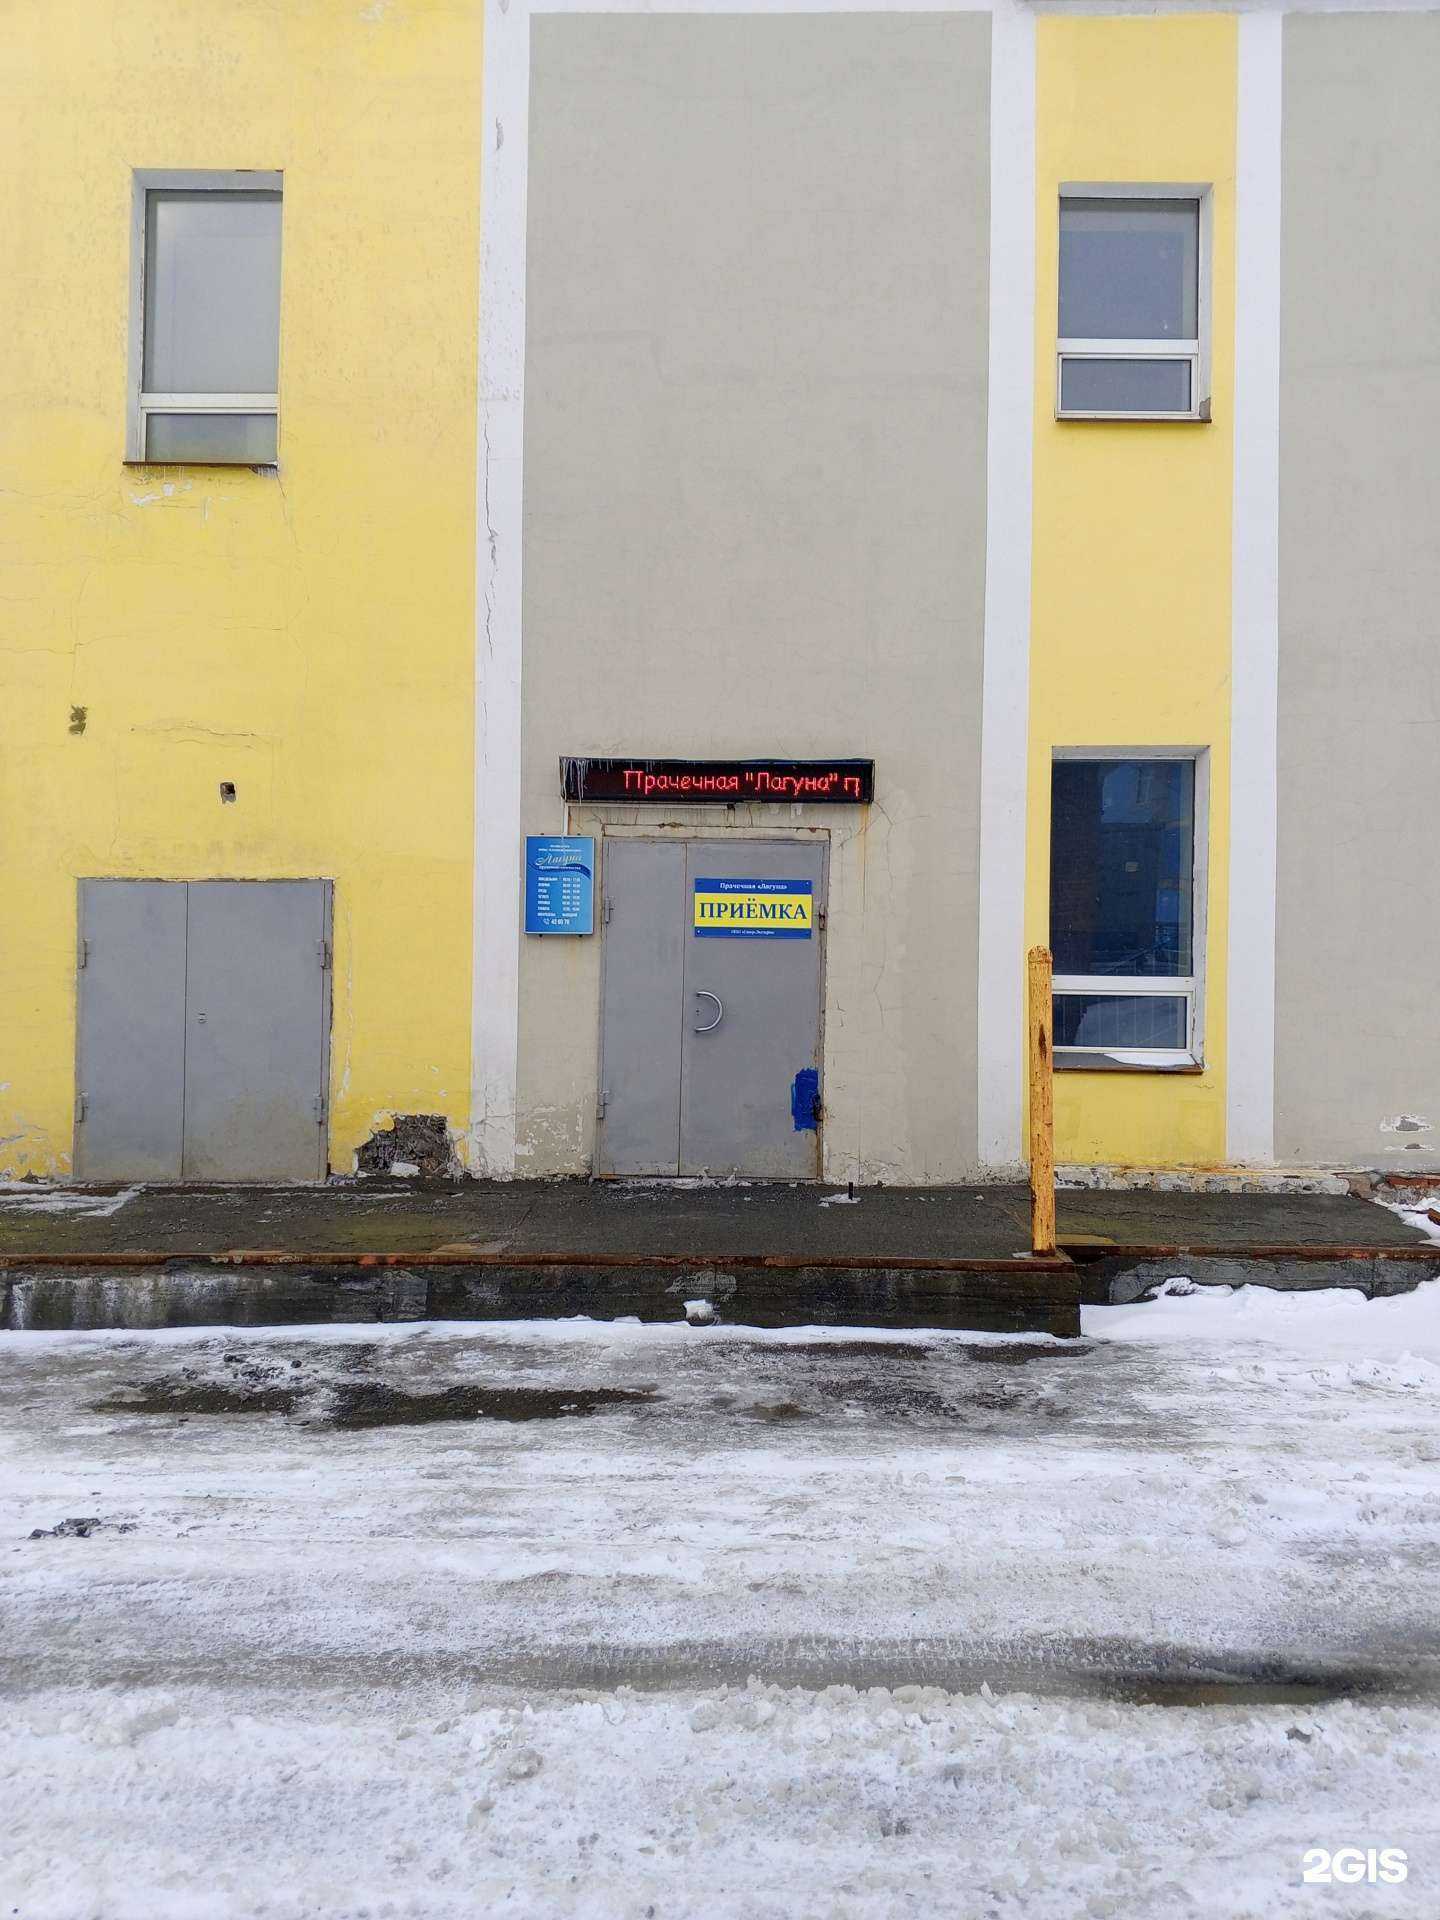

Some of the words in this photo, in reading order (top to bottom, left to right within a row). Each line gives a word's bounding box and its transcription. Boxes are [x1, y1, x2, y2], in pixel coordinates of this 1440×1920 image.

[623, 770, 739, 795] Прачечная
[745, 772, 838, 796] "Лагуна"
[699, 897, 808, 920] ПРИЁМКА
